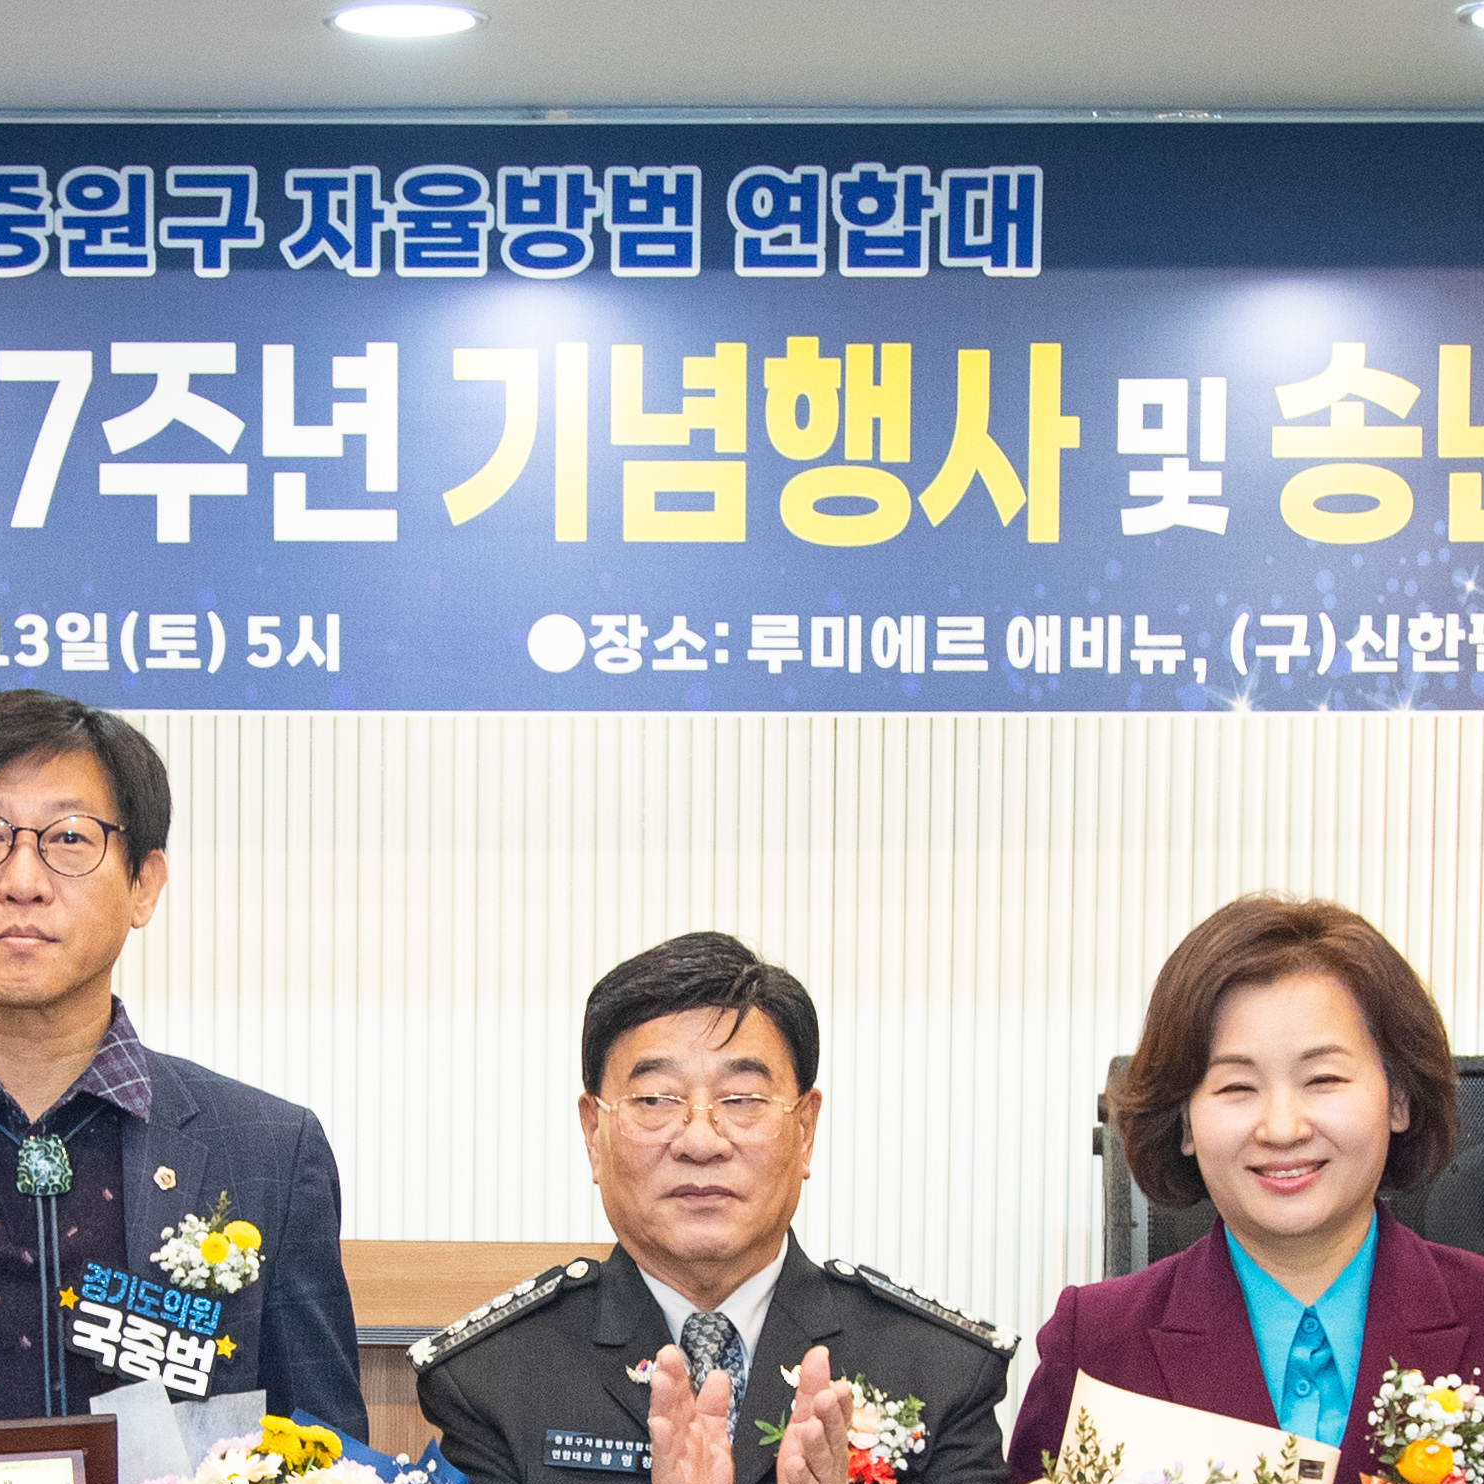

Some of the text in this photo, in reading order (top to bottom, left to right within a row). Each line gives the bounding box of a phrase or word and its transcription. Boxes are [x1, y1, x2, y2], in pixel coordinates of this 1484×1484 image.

[281, 164, 702, 280] 자율방범
[727, 163, 1043, 279] 연합대
[442, 336, 1081, 548] 기념행사
[1117, 376, 1230, 537] 및
[247, 613, 341, 673] 5시
[588, 613, 730, 673] 장소:
[748, 614, 990, 675] 루미에르
[1006, 614, 1208, 684] 애비뉴,
[81, 1262, 222, 1336] 경기도의원
[72, 1301, 217, 1397] 국중범
